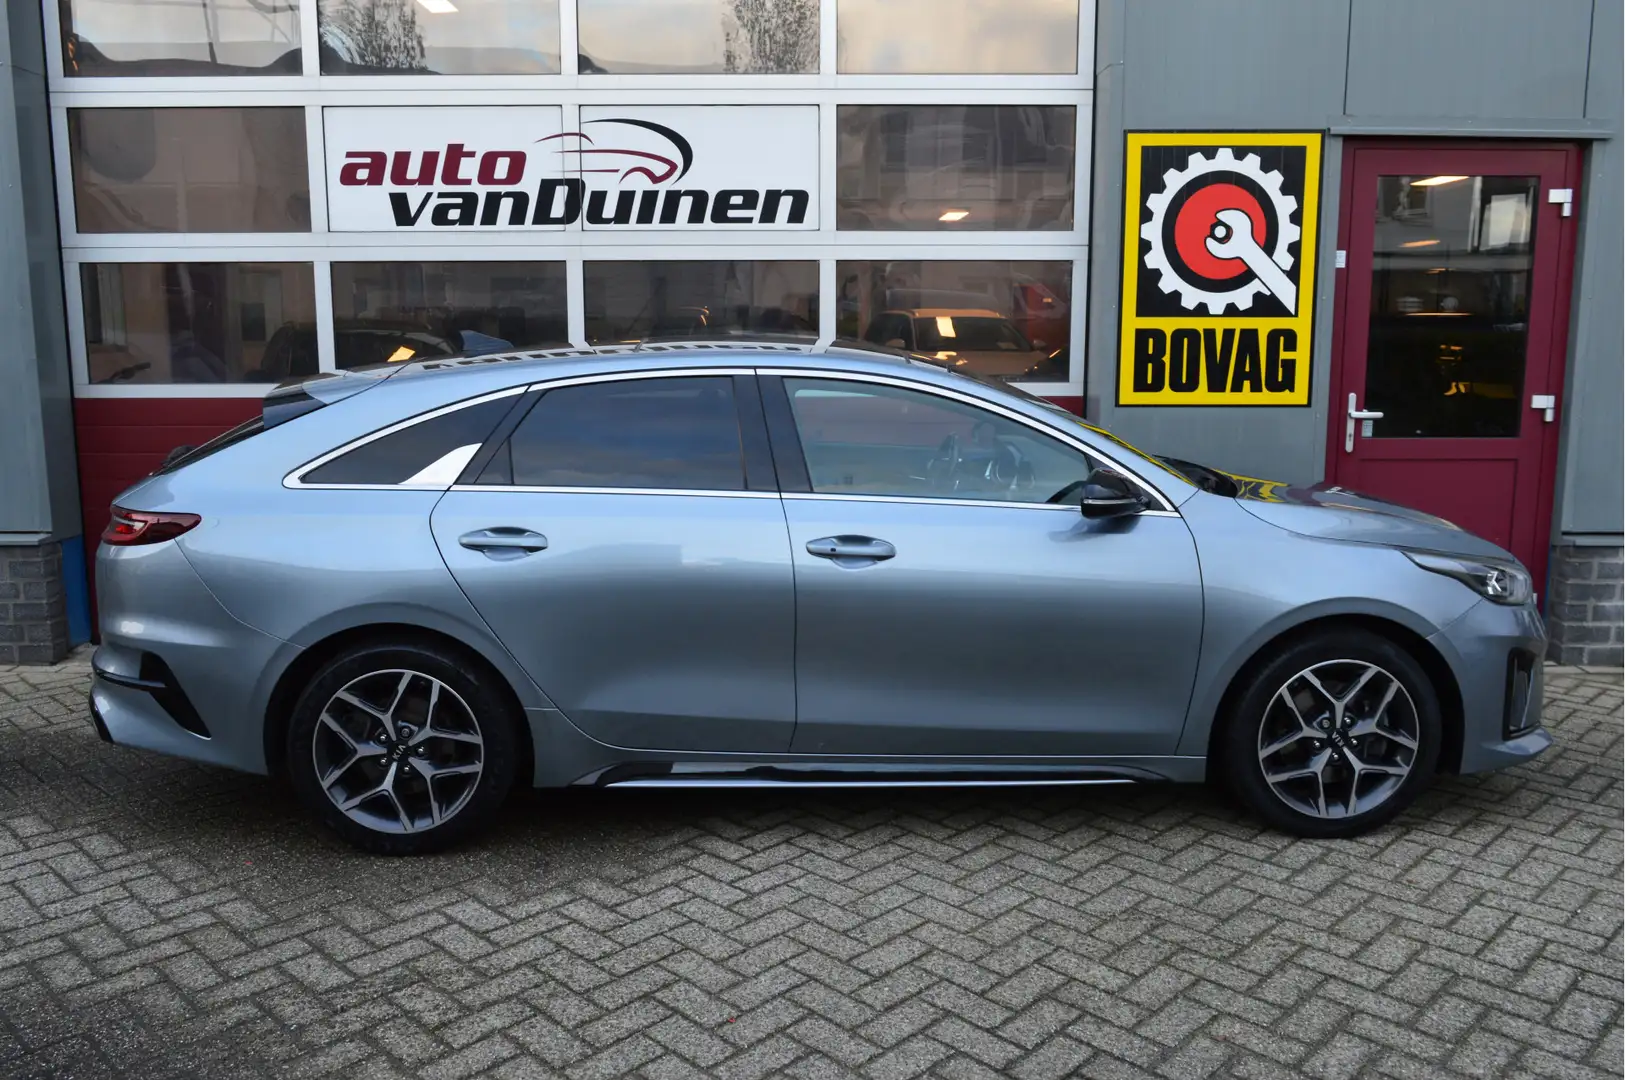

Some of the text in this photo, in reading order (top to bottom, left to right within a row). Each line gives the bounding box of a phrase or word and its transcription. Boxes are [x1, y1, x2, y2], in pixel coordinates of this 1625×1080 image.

[340, 144, 526, 186] auto
[389, 178, 809, 227] vanDuinen
[1133, 328, 1298, 393] BOVAG
[391, 744, 406, 760] KIA
